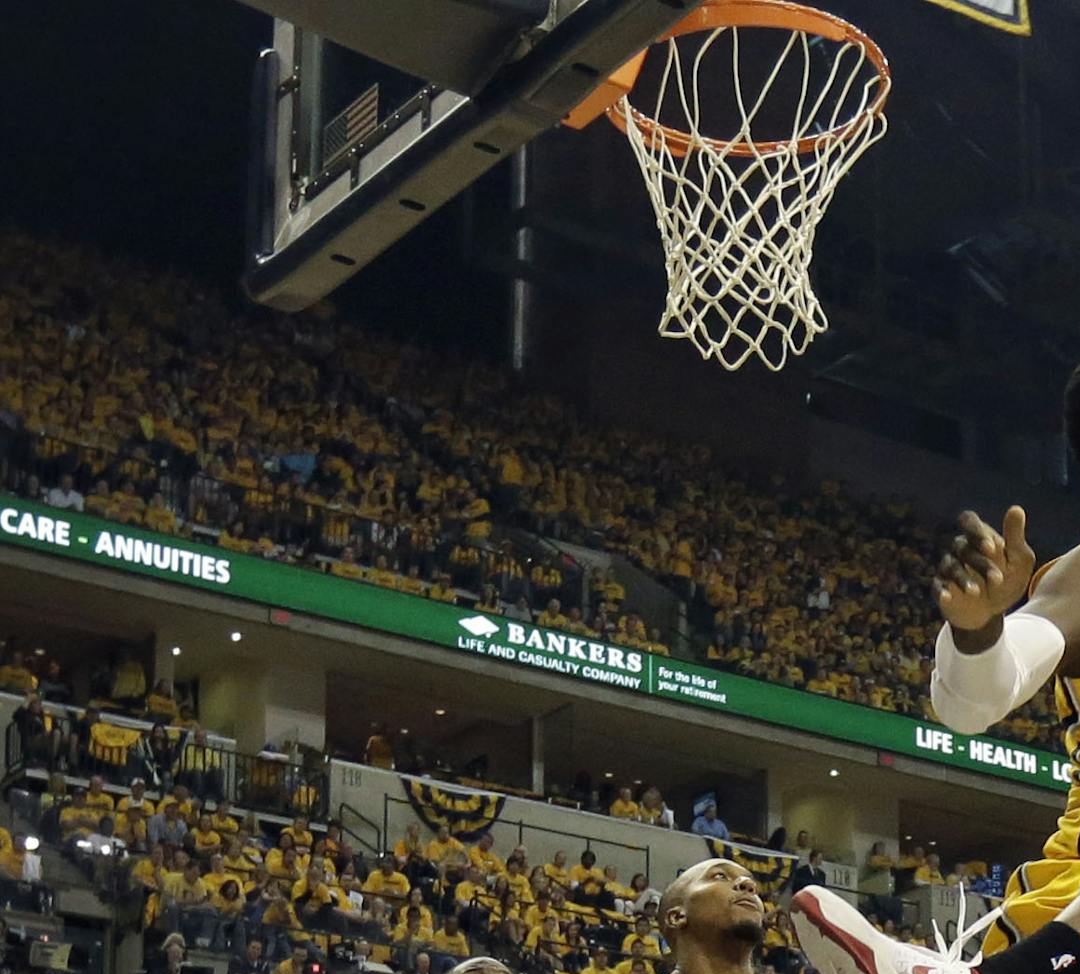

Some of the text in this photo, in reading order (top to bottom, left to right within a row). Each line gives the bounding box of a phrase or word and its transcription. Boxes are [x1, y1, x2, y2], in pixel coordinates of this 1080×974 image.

[0, 508, 71, 546] CARE
[95, 531, 231, 584] ANNUITIES
[458, 636, 642, 690] LIFE AND CASUALTY COMPANY
[507, 623, 643, 673] BANKERS
[658, 666, 673, 679] For
[675, 671, 690, 683] the
[691, 674, 705, 687] life
[658, 680, 679, 691] your
[916, 726, 953, 754] LIFE
[969, 740, 1037, 774] HEALTH
[1052, 760, 1073, 783] LO
